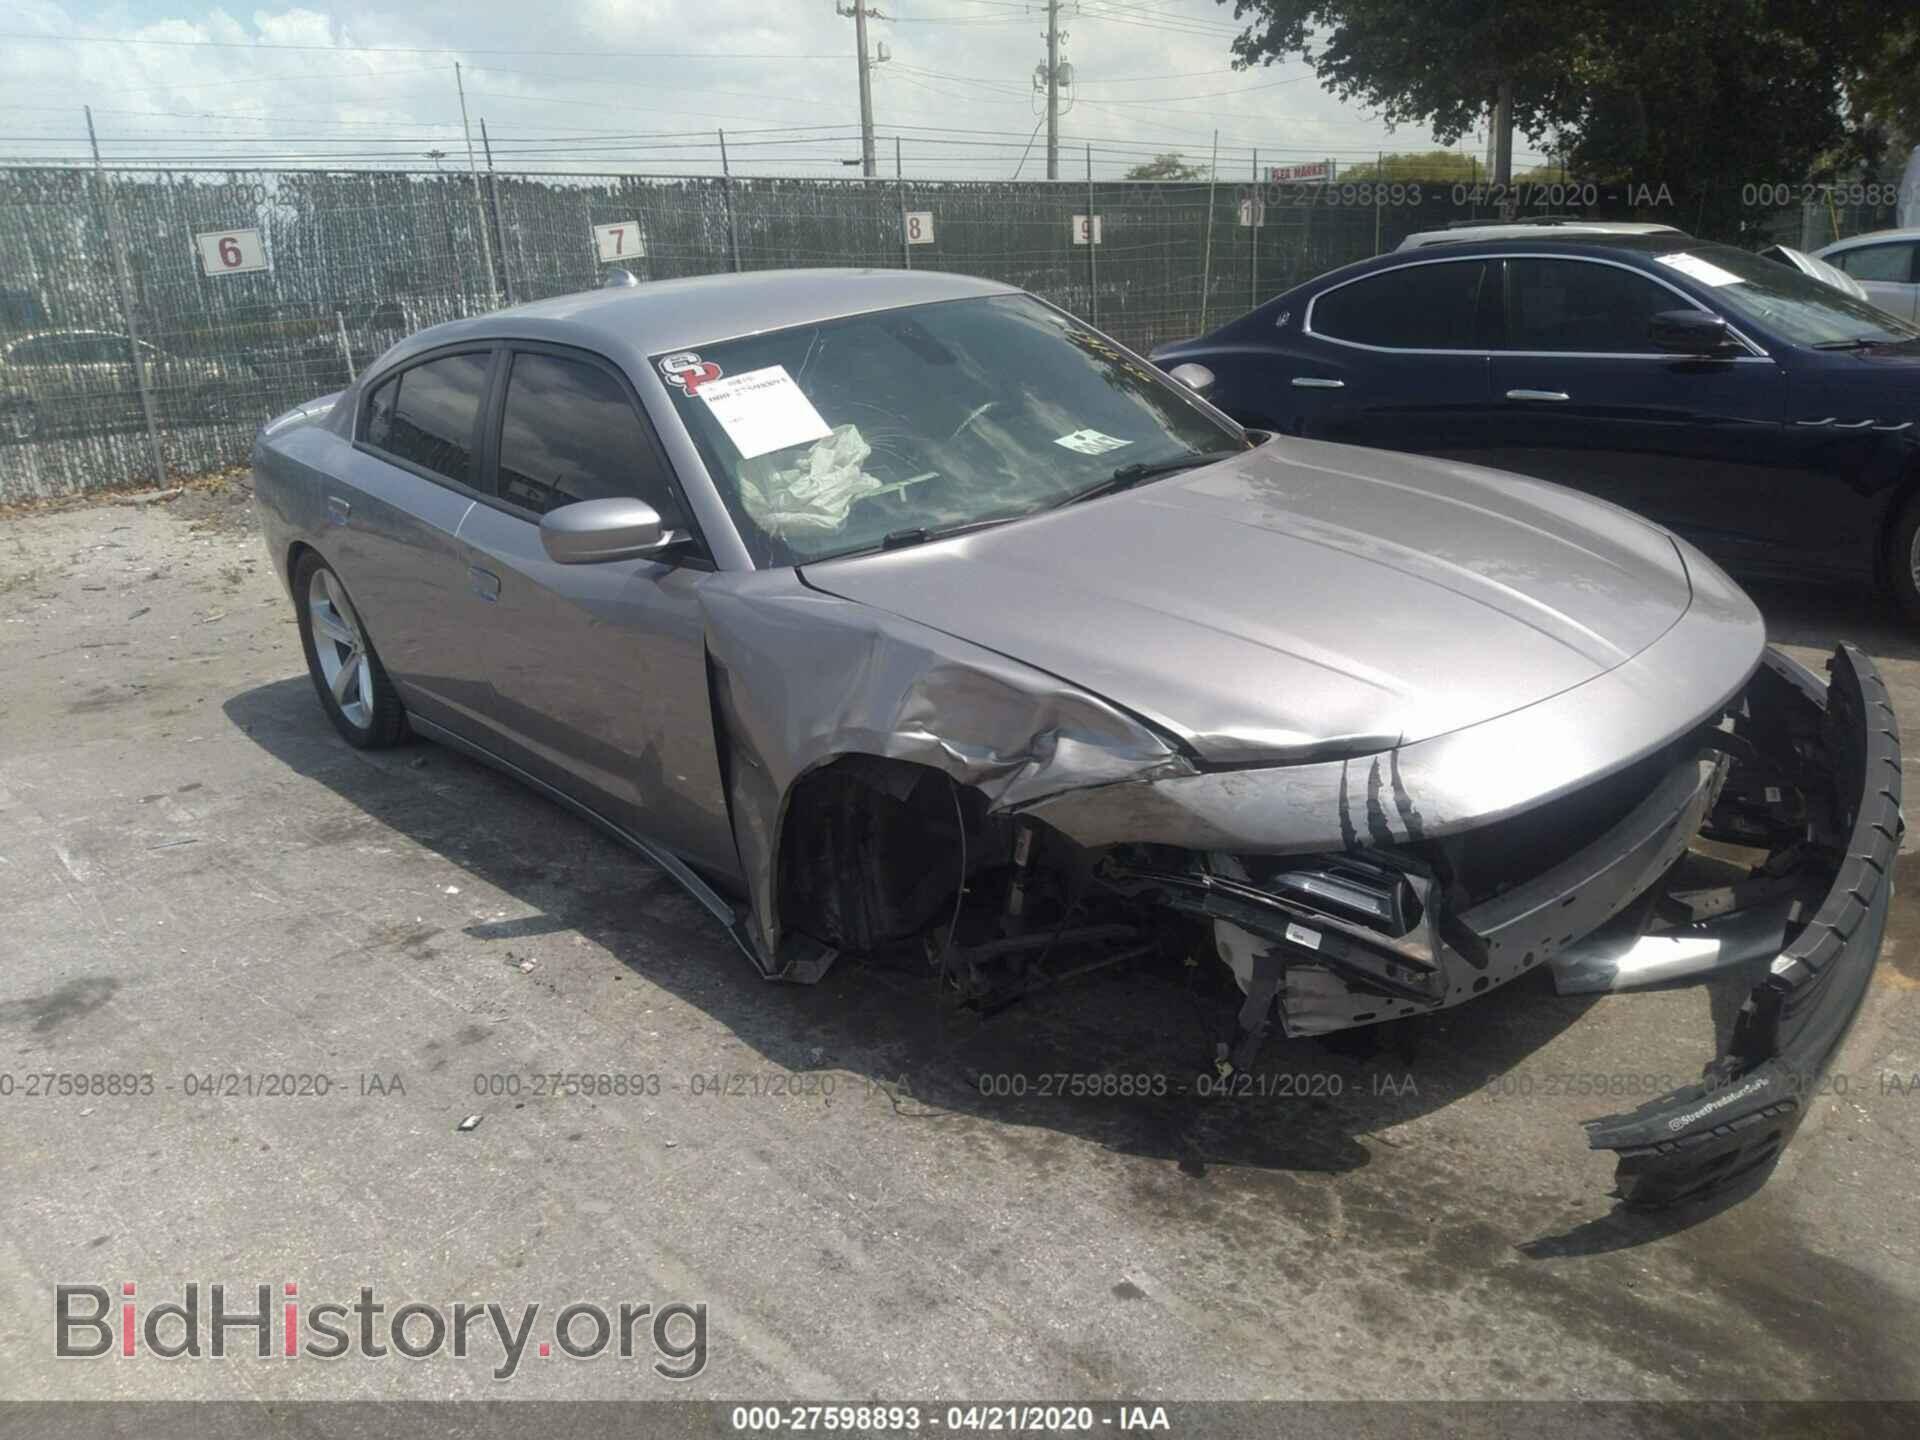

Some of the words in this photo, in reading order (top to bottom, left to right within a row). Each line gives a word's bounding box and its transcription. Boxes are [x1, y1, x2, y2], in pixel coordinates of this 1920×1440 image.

[608, 228, 625, 255] 7
[908, 216, 921, 241] 8
[1081, 220, 1093, 240] 9
[218, 236, 243, 268] 6
